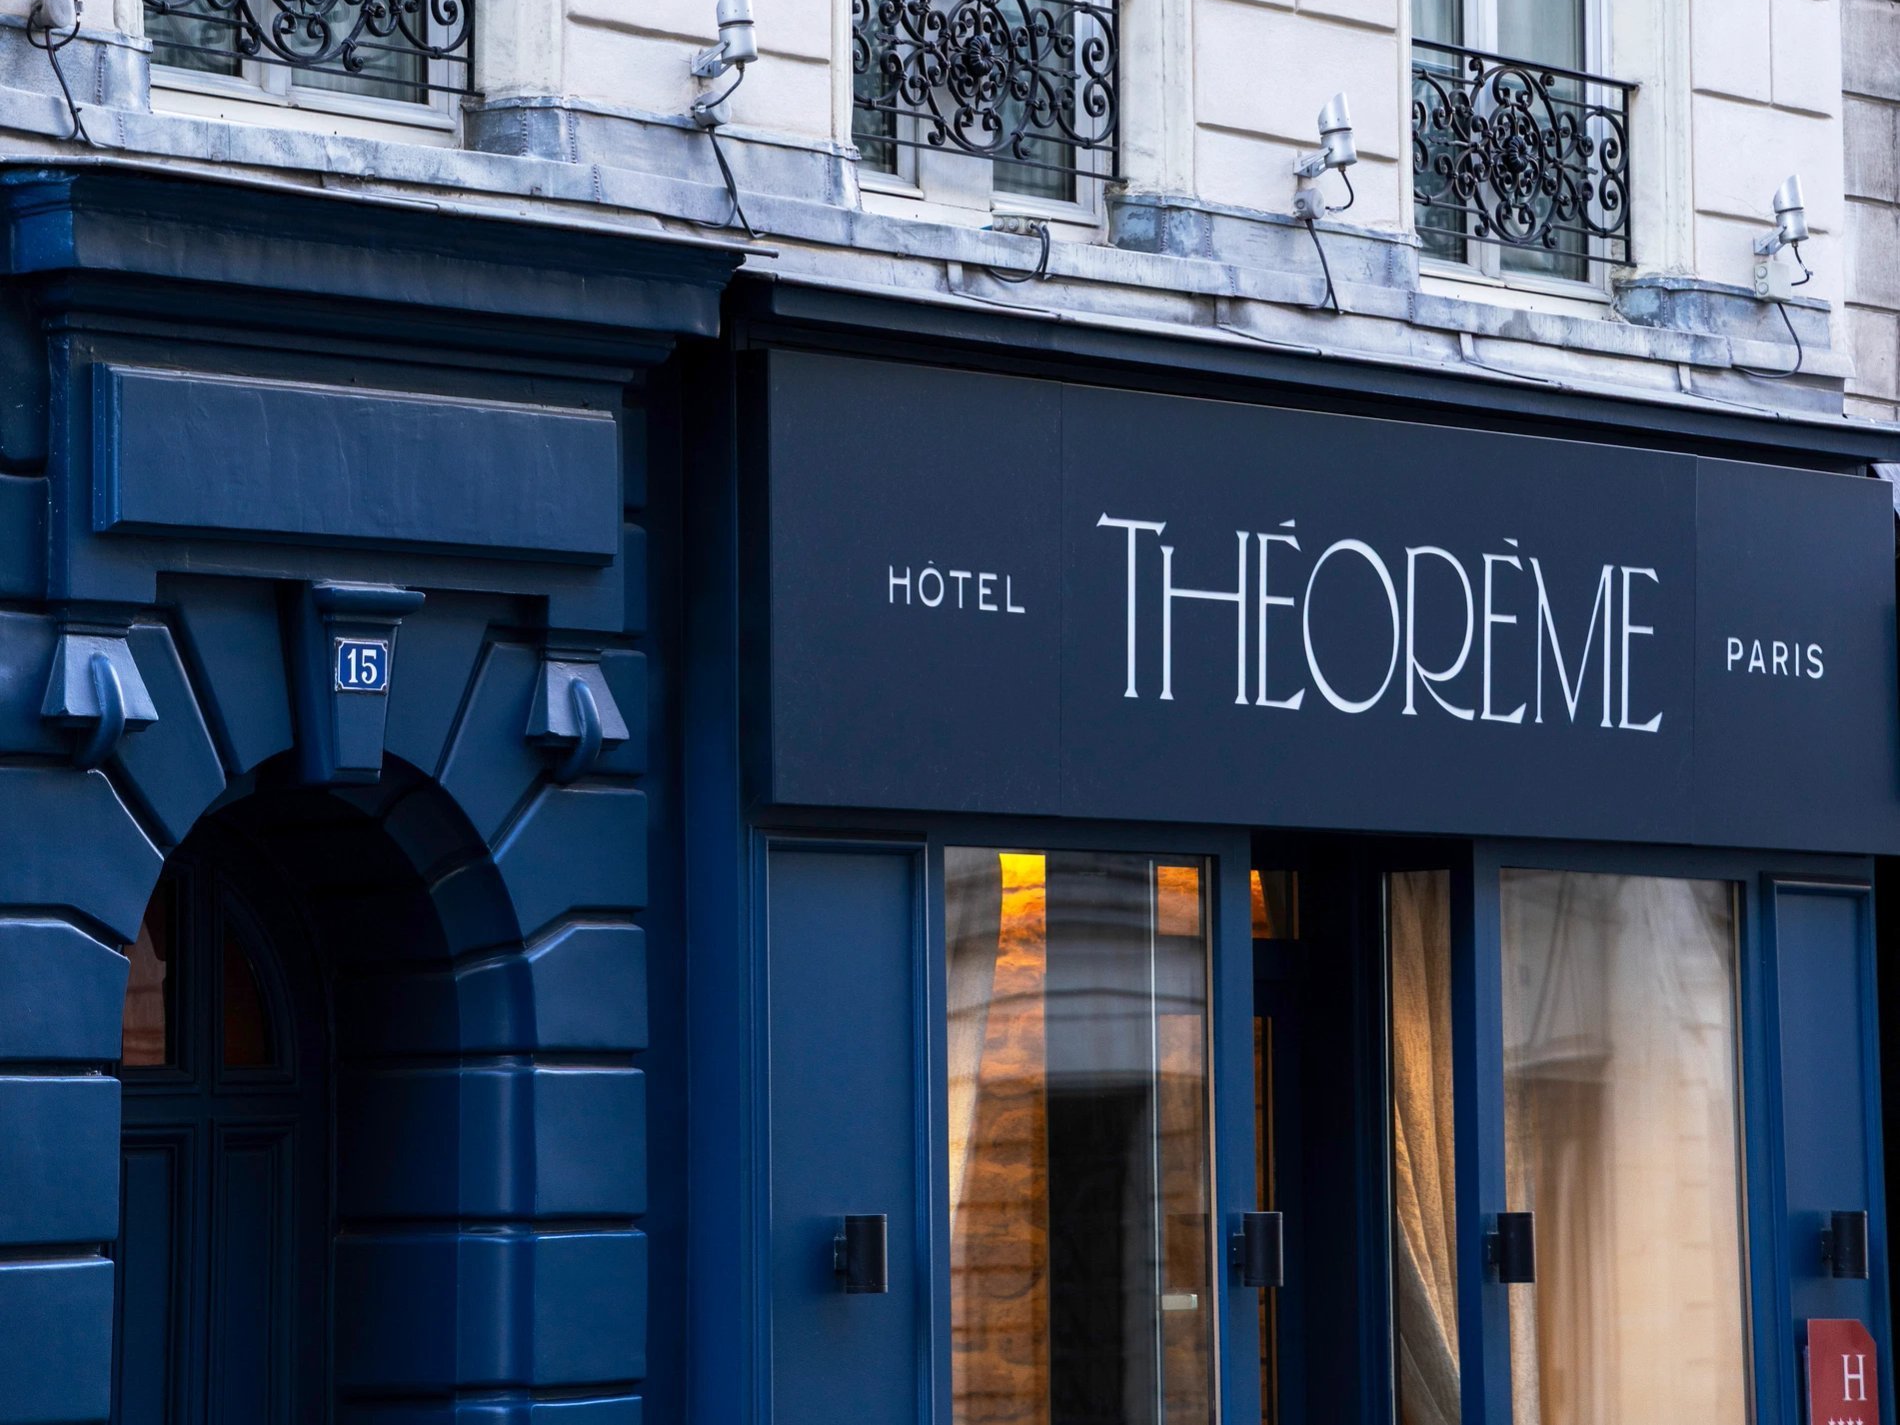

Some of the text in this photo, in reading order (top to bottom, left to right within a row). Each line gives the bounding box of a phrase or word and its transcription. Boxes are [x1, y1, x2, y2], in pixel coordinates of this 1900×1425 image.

[888, 512, 1824, 733] HÔTEL THÉORÈME PARIS
[347, 648, 378, 684] 15
[1841, 1354, 1867, 1401] H
